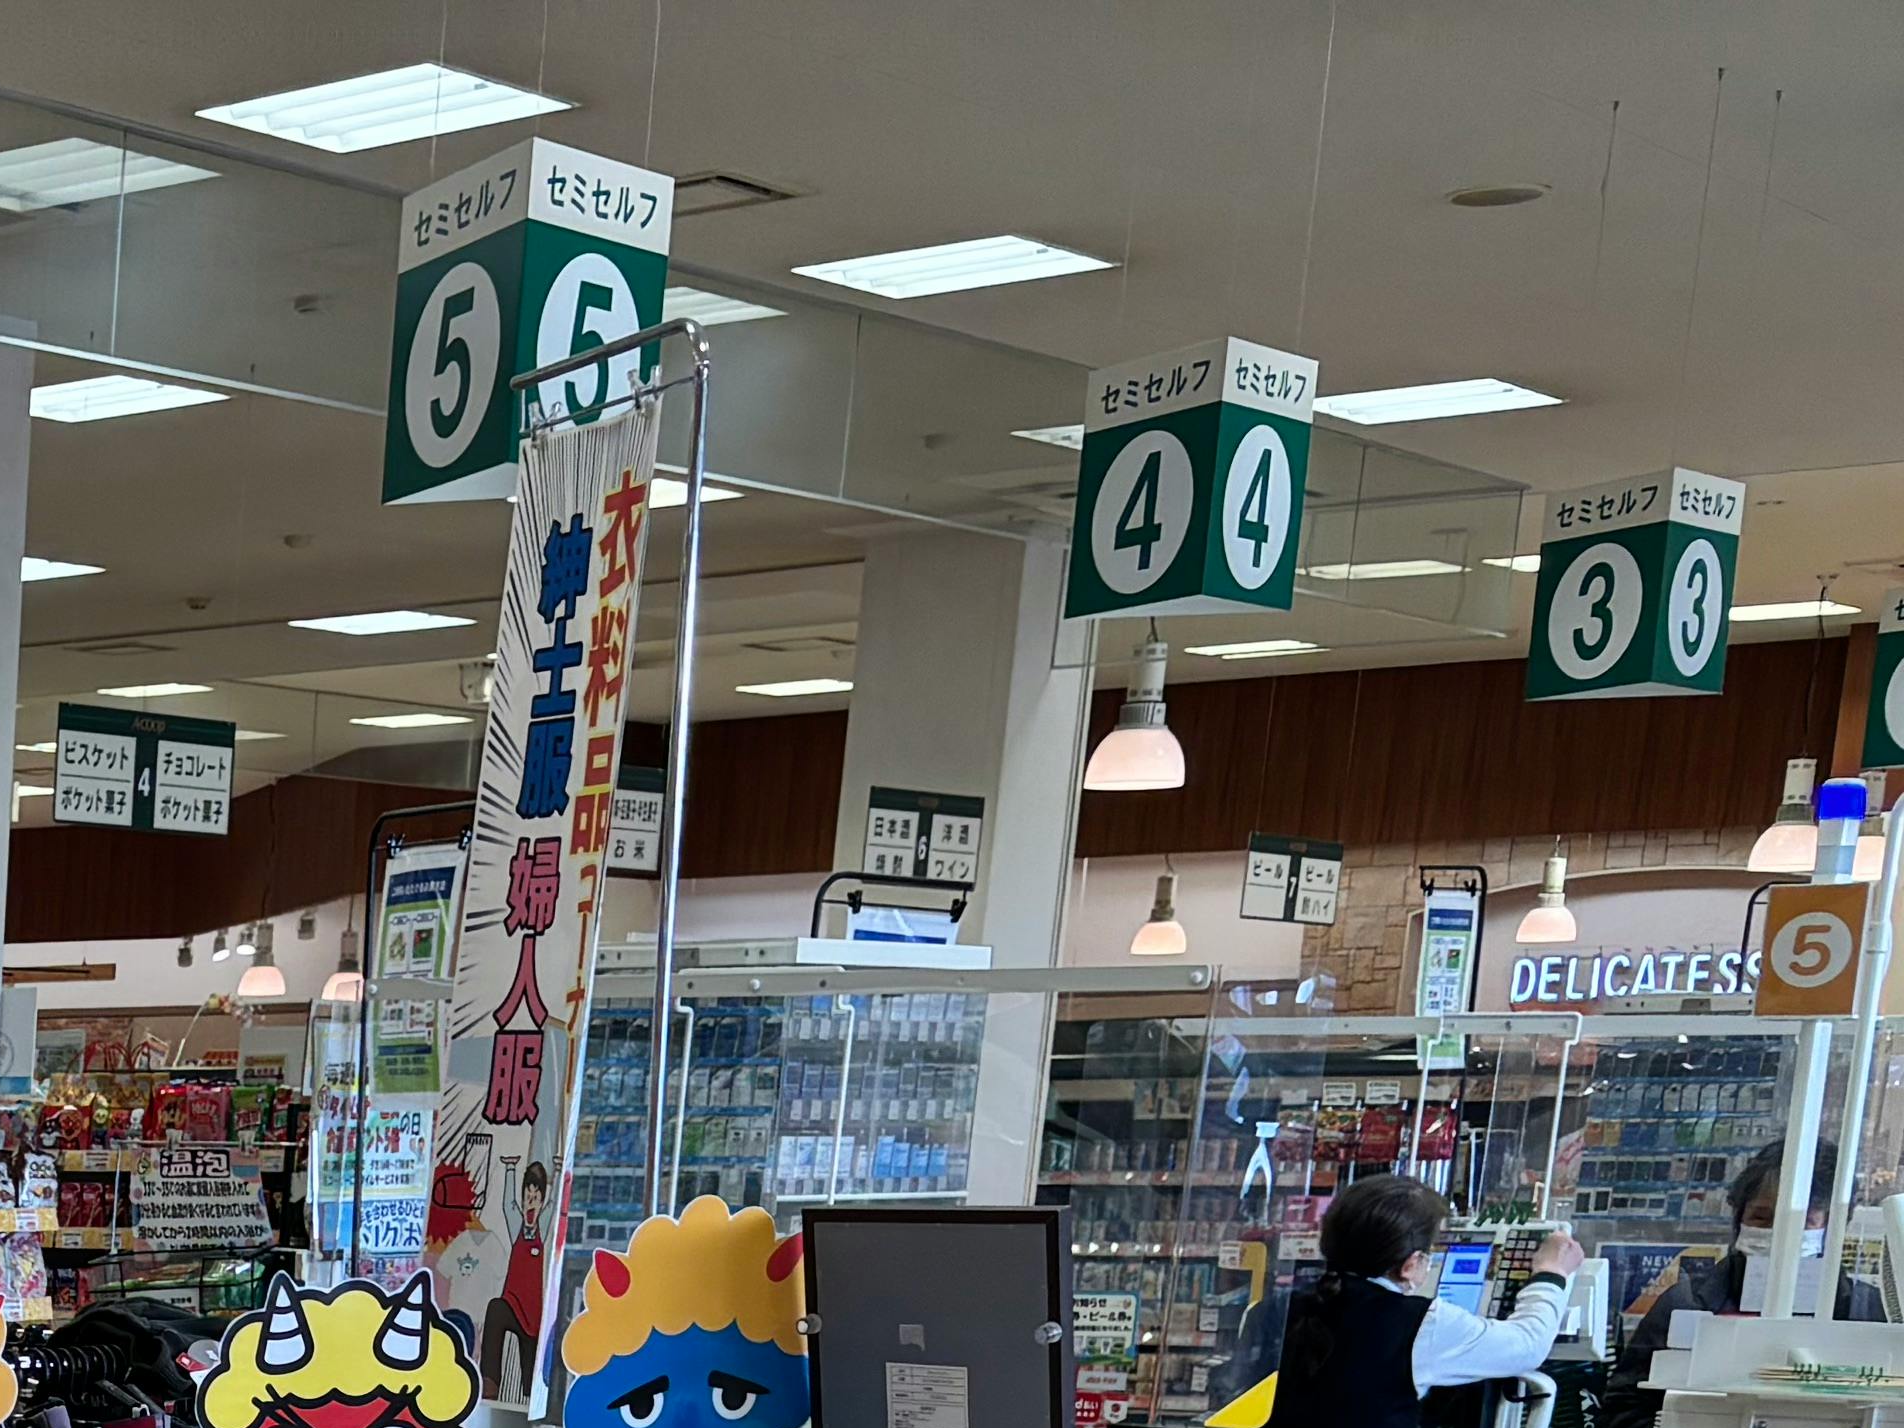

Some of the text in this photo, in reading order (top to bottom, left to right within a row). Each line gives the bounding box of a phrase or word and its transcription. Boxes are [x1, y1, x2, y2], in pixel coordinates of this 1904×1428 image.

[414, 168, 517, 248] セミセルフ
[547, 165, 657, 229] セミセルフ
[431, 287, 475, 439] 5
[1102, 360, 1210, 414] セミセルフ
[1235, 358, 1307, 404] セミセルフ
[1114, 450, 1162, 570] 4
[1238, 448, 1272, 568] 4
[1557, 485, 1659, 528] セミセルフ
[1572, 562, 1615, 661] 3
[1681, 558, 1708, 658] 3
[518, 512, 592, 820] 紳士服
[64, 741, 129, 771] ビスケット
[137, 767, 150, 797] 4
[163, 752, 226, 781] チョコレート
[935, 860, 970, 880] ワイン
[1252, 859, 1283, 878] ビール
[1305, 866, 1335, 883] ビール
[1790, 924, 1831, 977] 5
[483, 835, 563, 1126] 婦人服
[160, 1150, 230, 1177] 温泡
